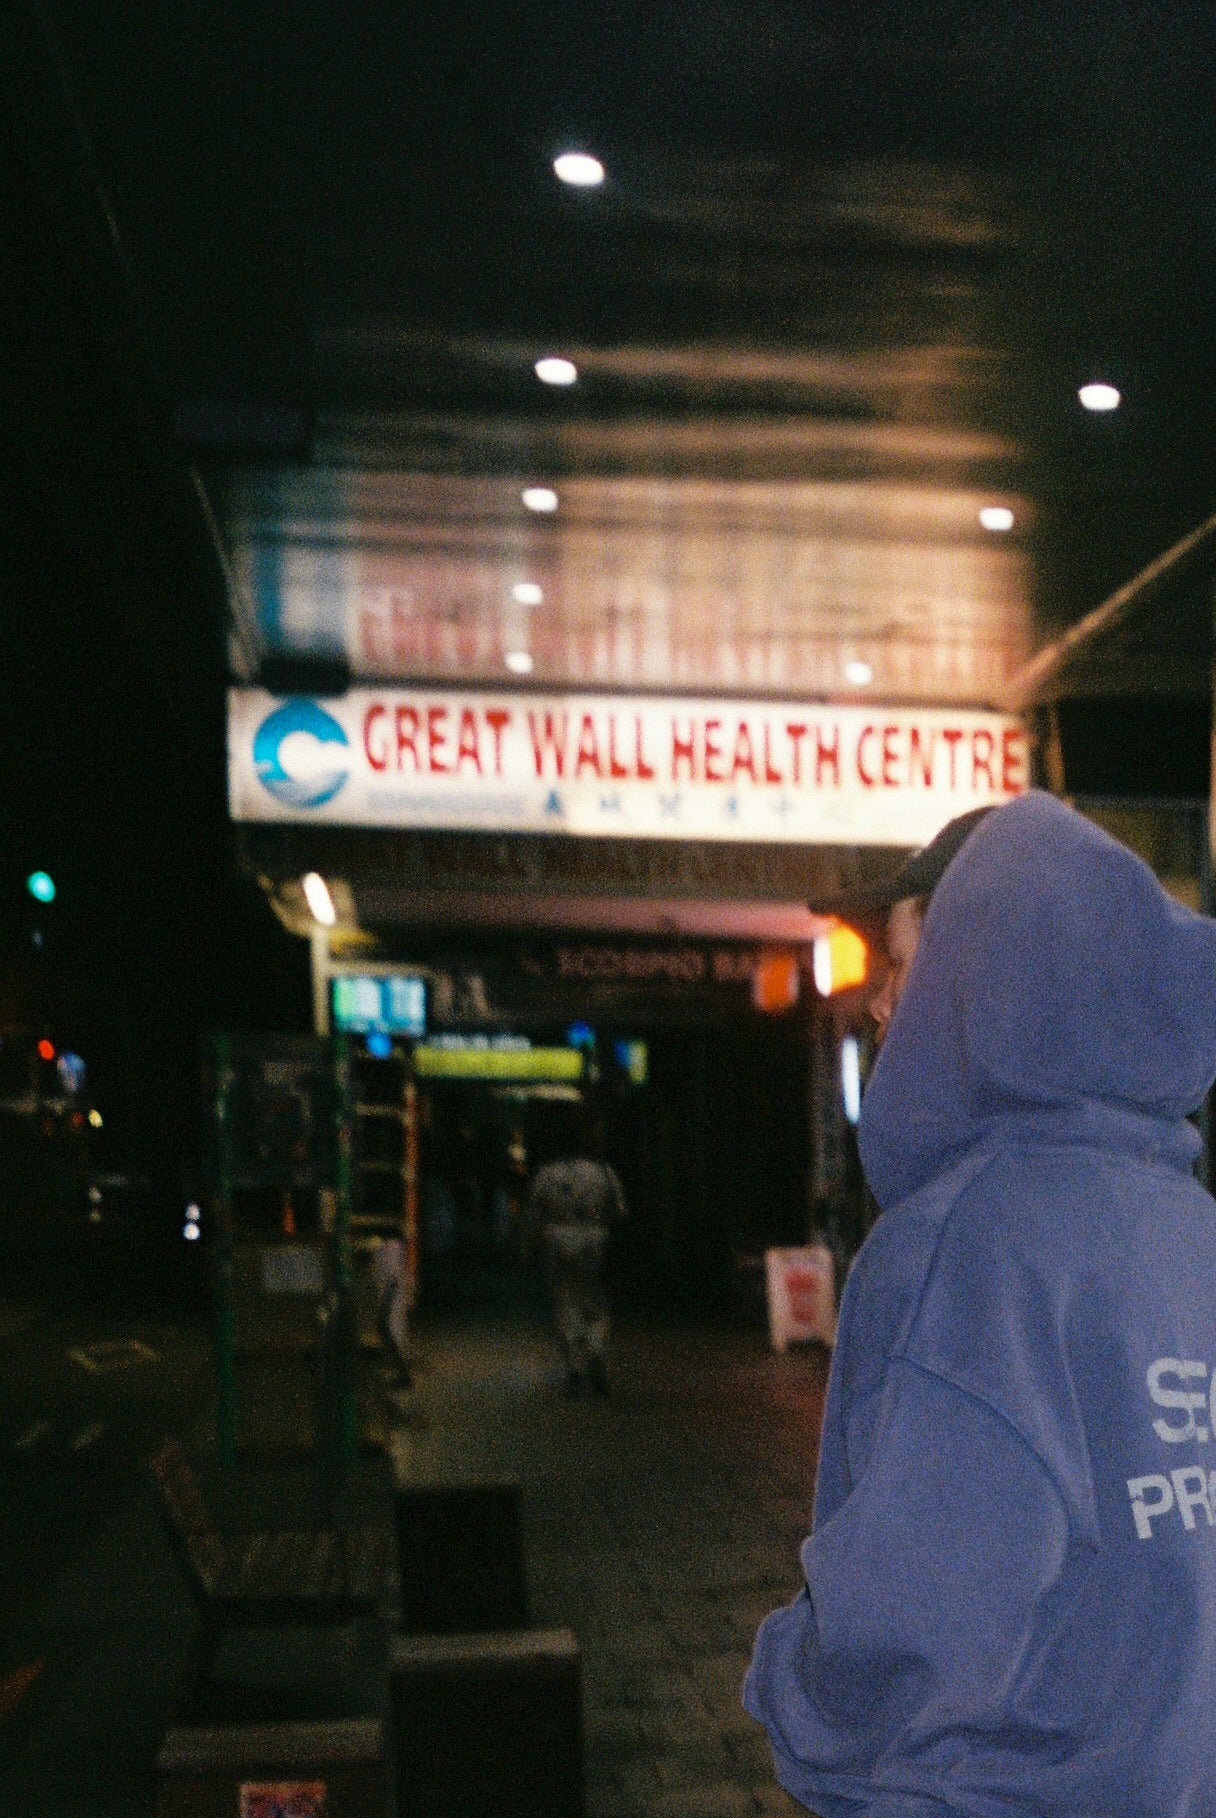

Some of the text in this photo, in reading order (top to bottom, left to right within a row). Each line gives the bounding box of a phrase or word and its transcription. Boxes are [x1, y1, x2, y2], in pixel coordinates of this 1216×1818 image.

[363, 704, 1027, 794] GREAT WALL HEALTH CENTRE
